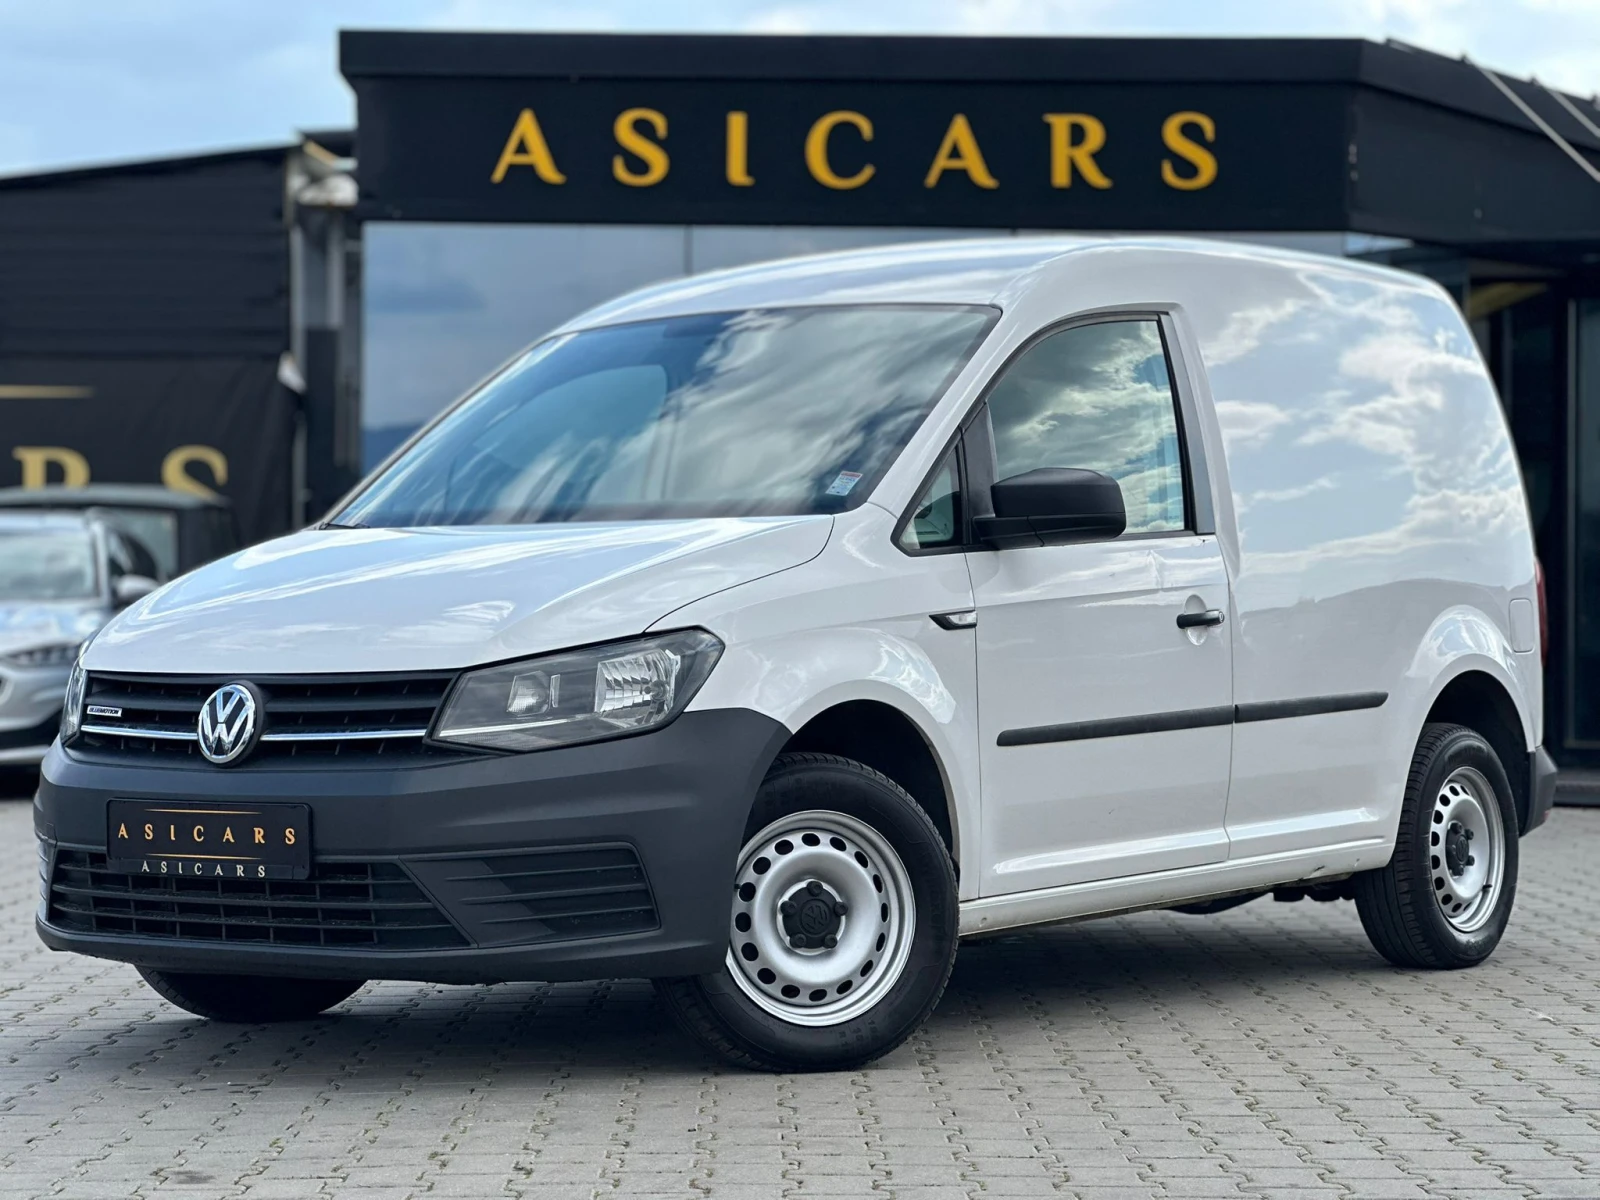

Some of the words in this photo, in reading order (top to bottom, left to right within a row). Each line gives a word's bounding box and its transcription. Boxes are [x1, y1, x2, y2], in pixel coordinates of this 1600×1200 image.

[491, 108, 1219, 191] ASICARS
[118, 822, 296, 845] ASICARS
[141, 860, 266, 878] ASICARS
